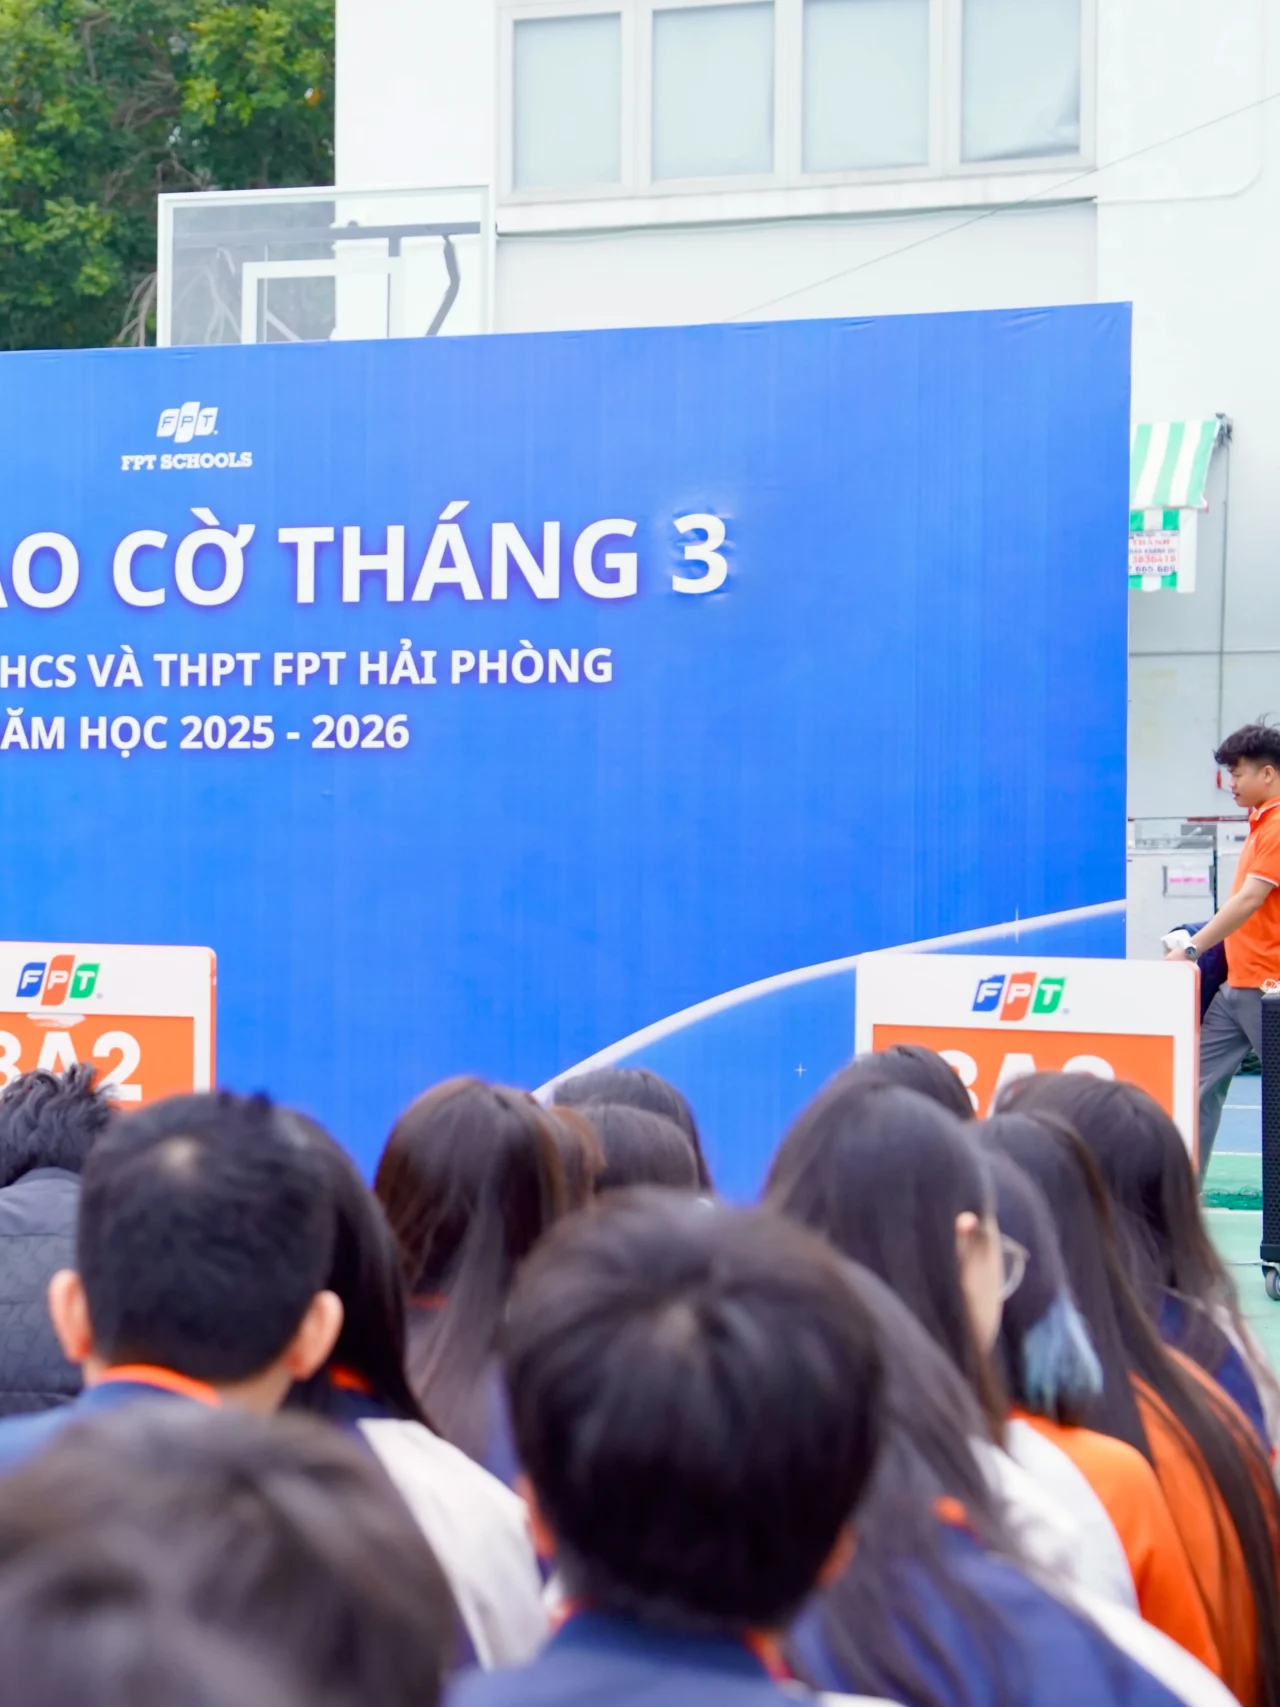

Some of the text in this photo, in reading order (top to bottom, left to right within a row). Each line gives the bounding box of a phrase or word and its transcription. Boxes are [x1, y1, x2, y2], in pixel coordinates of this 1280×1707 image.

[156, 401, 219, 444] FPT
[121, 451, 253, 471] FPT SCHOOLS
[112, 507, 256, 608] CỜ
[278, 500, 639, 604] THÁNG
[671, 513, 729, 594] 3
[87, 644, 143, 687] VÀ
[153, 652, 261, 687] THPT
[274, 652, 347, 686] FPT
[360, 638, 437, 685] HẢI
[451, 639, 613, 684] PHÒNG
[80, 715, 168, 758] HỌC
[180, 714, 275, 749] 2025
[311, 713, 410, 749] 2026
[16, 954, 101, 1006] FPT
[971, 971, 1067, 1021] FPT
